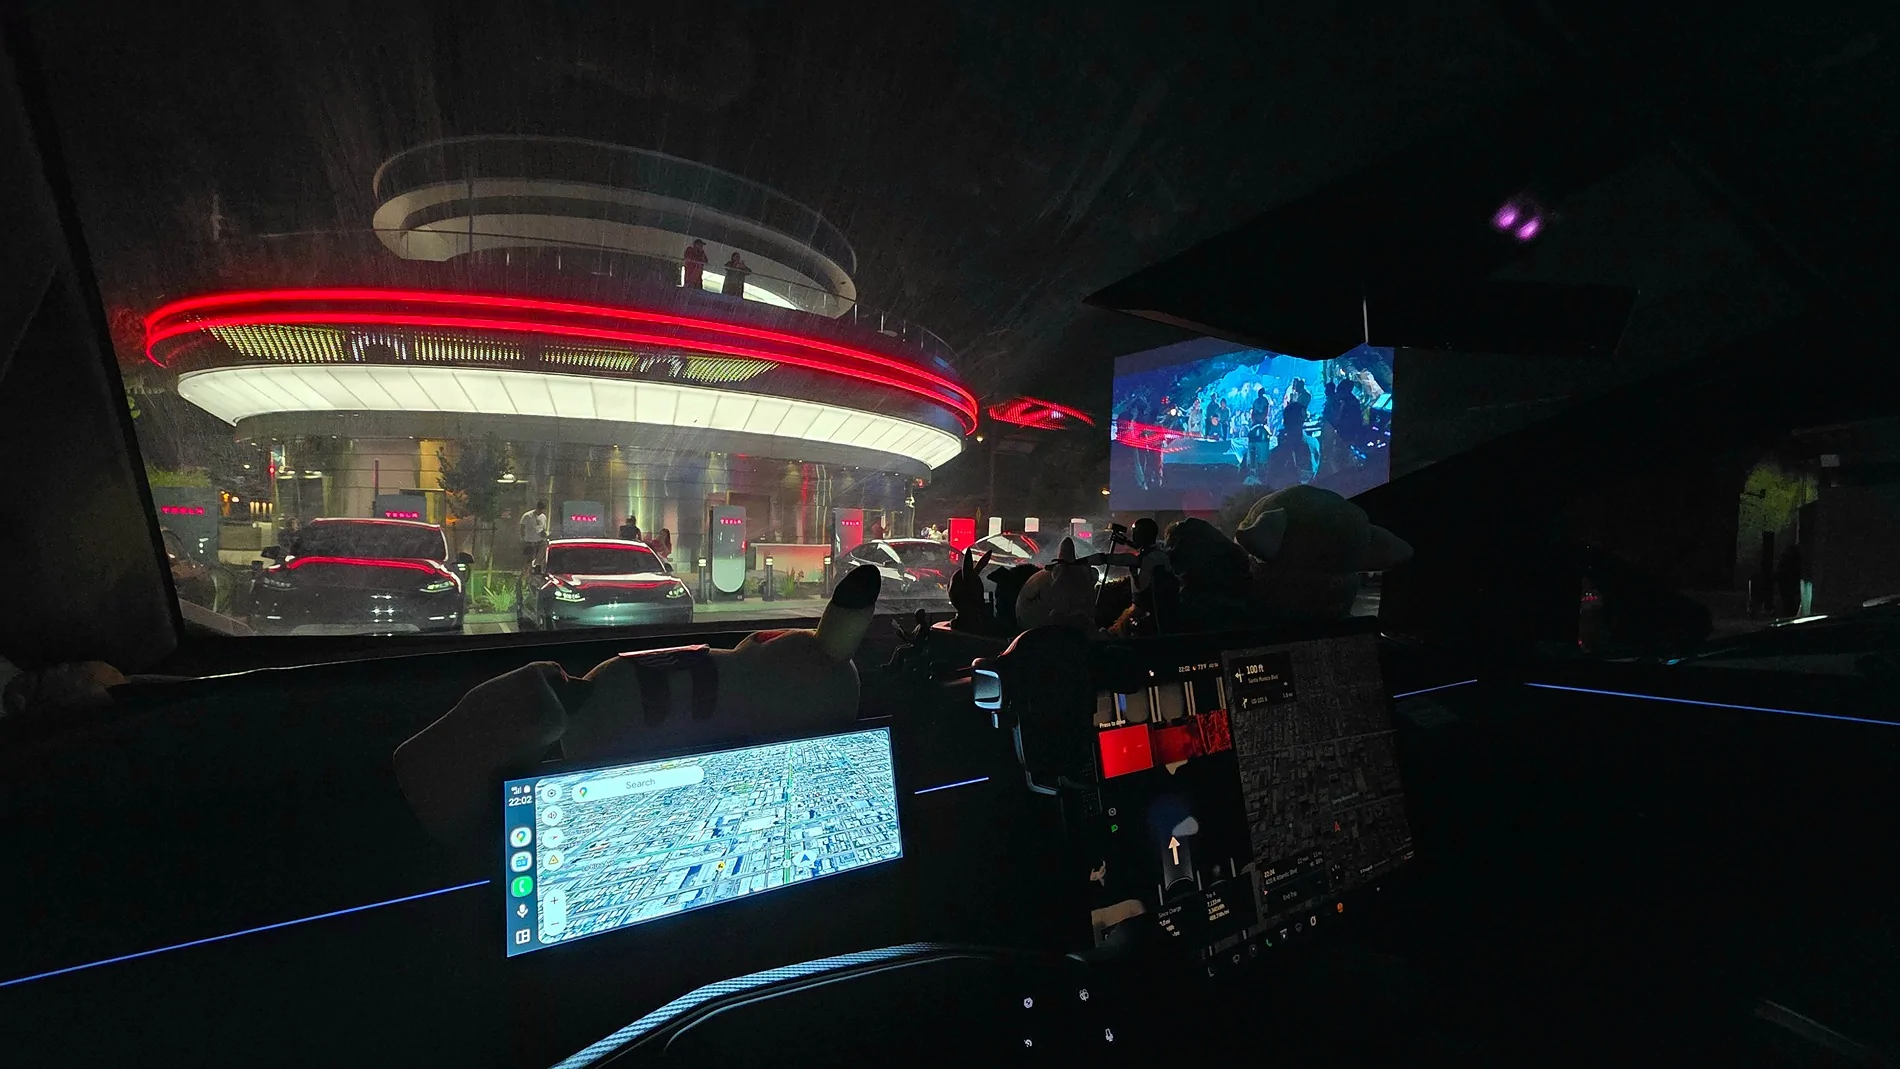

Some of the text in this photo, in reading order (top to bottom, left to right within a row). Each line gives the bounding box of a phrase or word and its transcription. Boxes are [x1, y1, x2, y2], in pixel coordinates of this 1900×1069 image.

[1246, 664, 1264, 675] 100 ft
[626, 779, 656, 790] Search
[508, 795, 533, 807] 22:02
